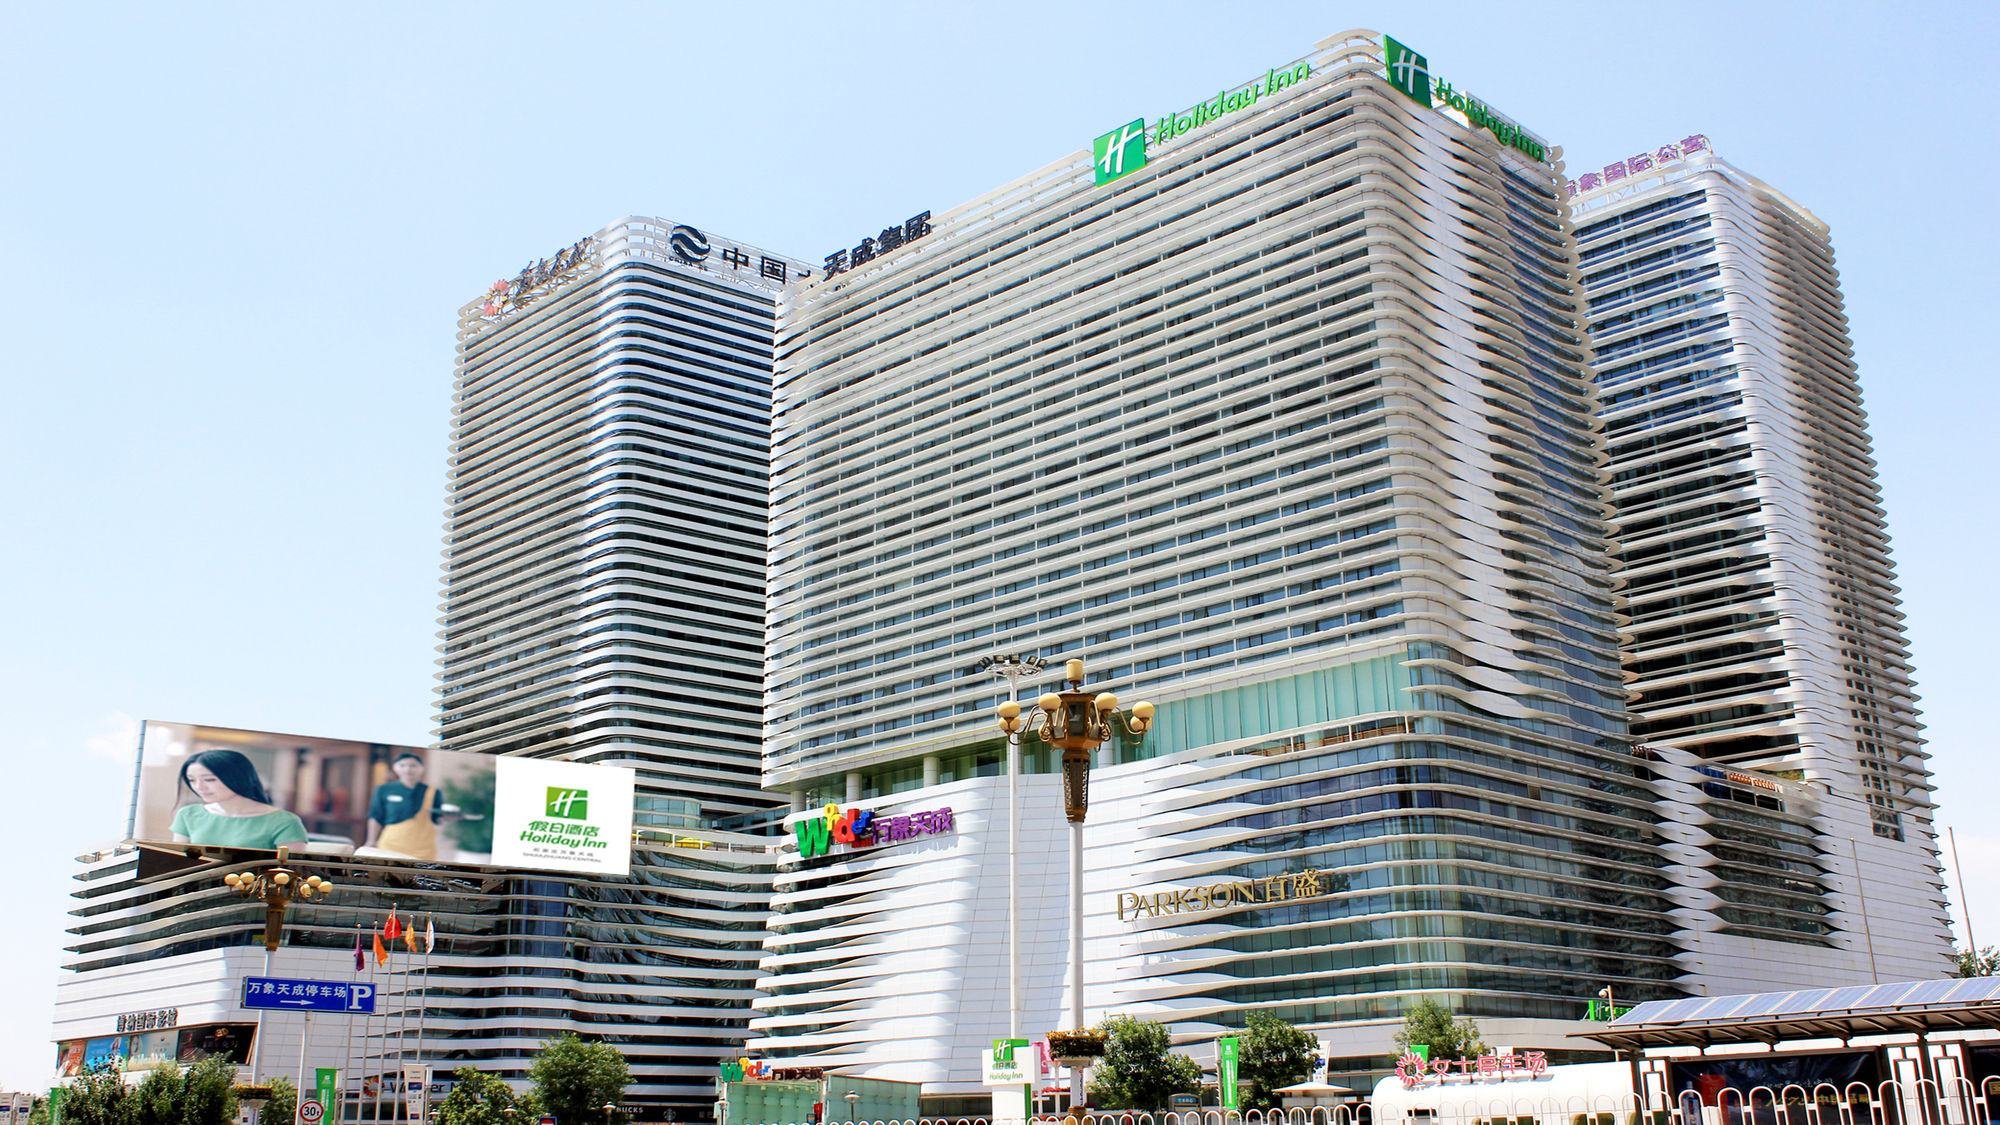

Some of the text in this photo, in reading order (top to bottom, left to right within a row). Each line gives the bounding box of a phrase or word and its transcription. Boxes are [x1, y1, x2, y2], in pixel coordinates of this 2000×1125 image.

[1155, 62, 1311, 145] Holiday Inn
[1435, 77, 1545, 162] Holiday Inn
[824, 210, 931, 282] 天成集团
[723, 247, 812, 285] 中国
[519, 830, 608, 849] Holiday Inn
[528, 820, 600, 837] 假日酒店
[1117, 868, 1321, 920] PARKSON 百盛
[248, 982, 372, 1010] 万象天成停车场 P
[1429, 1051, 1548, 1078] 女士停车场
